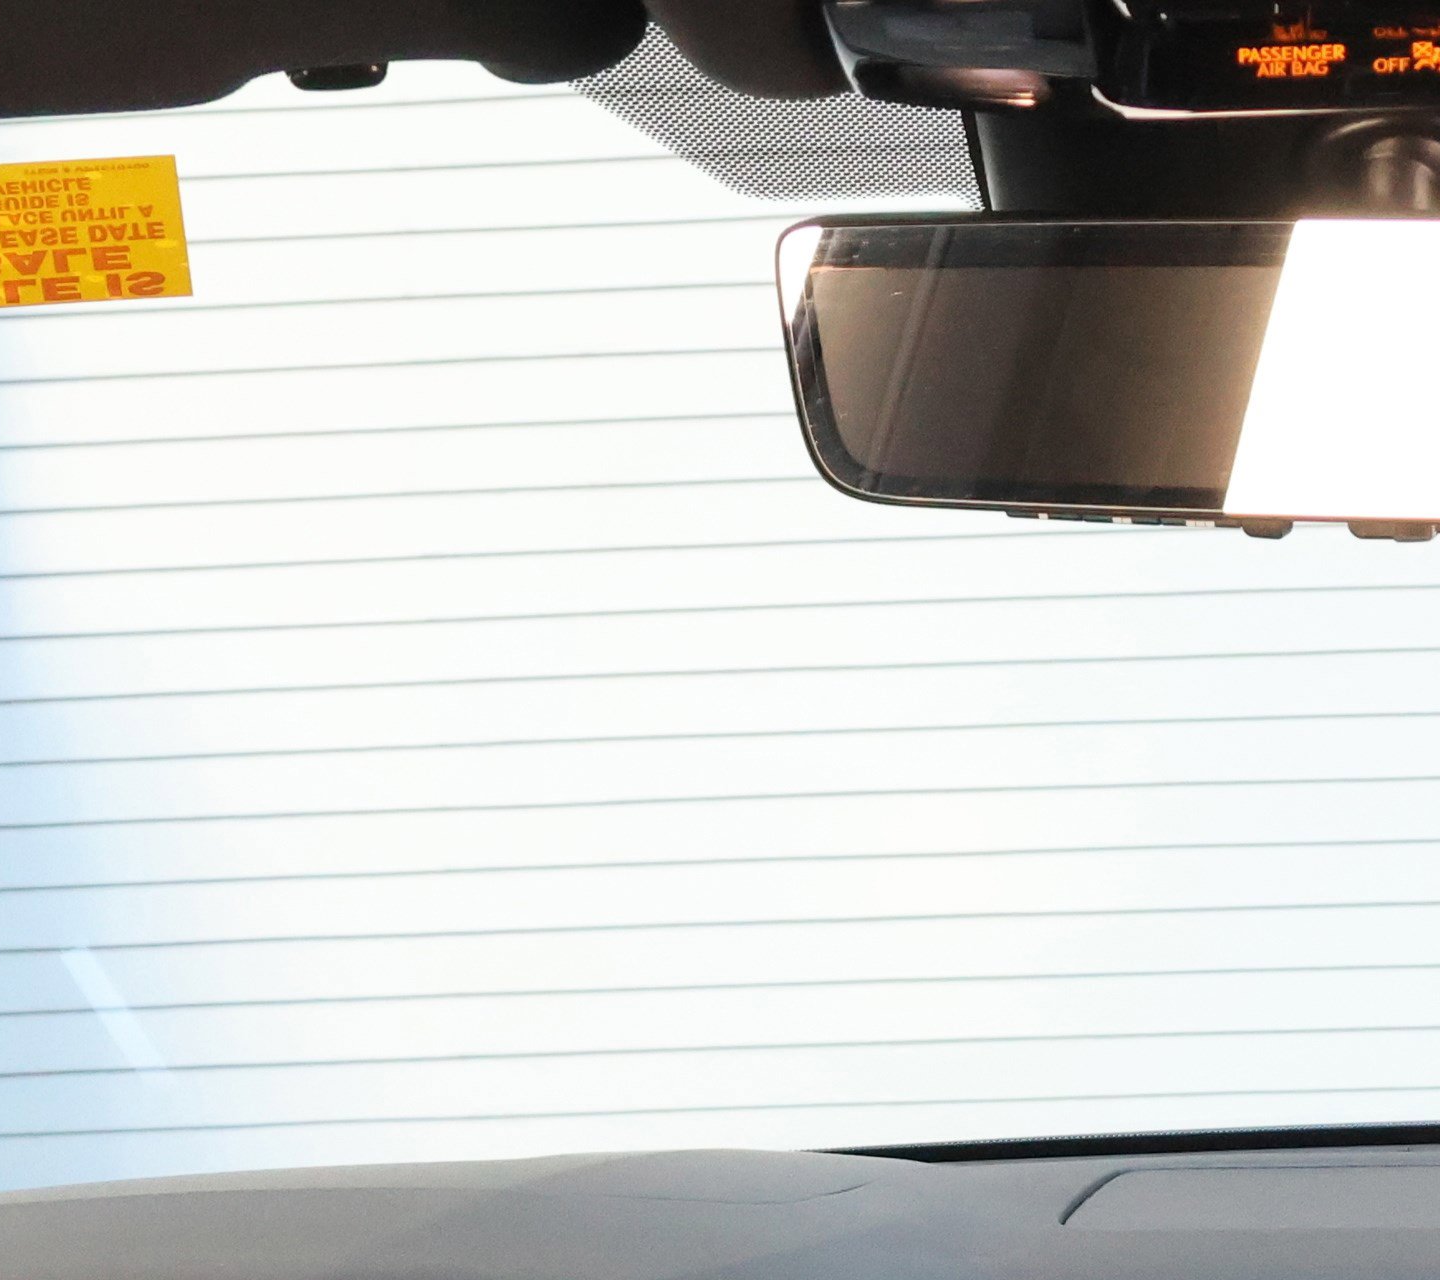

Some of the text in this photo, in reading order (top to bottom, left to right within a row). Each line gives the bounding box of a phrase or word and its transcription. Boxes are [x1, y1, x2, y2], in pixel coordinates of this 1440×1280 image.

[1238, 44, 1345, 64] PASSENGER
[1257, 60, 1329, 78] AIR BAG
[1372, 58, 1410, 73] OFF
